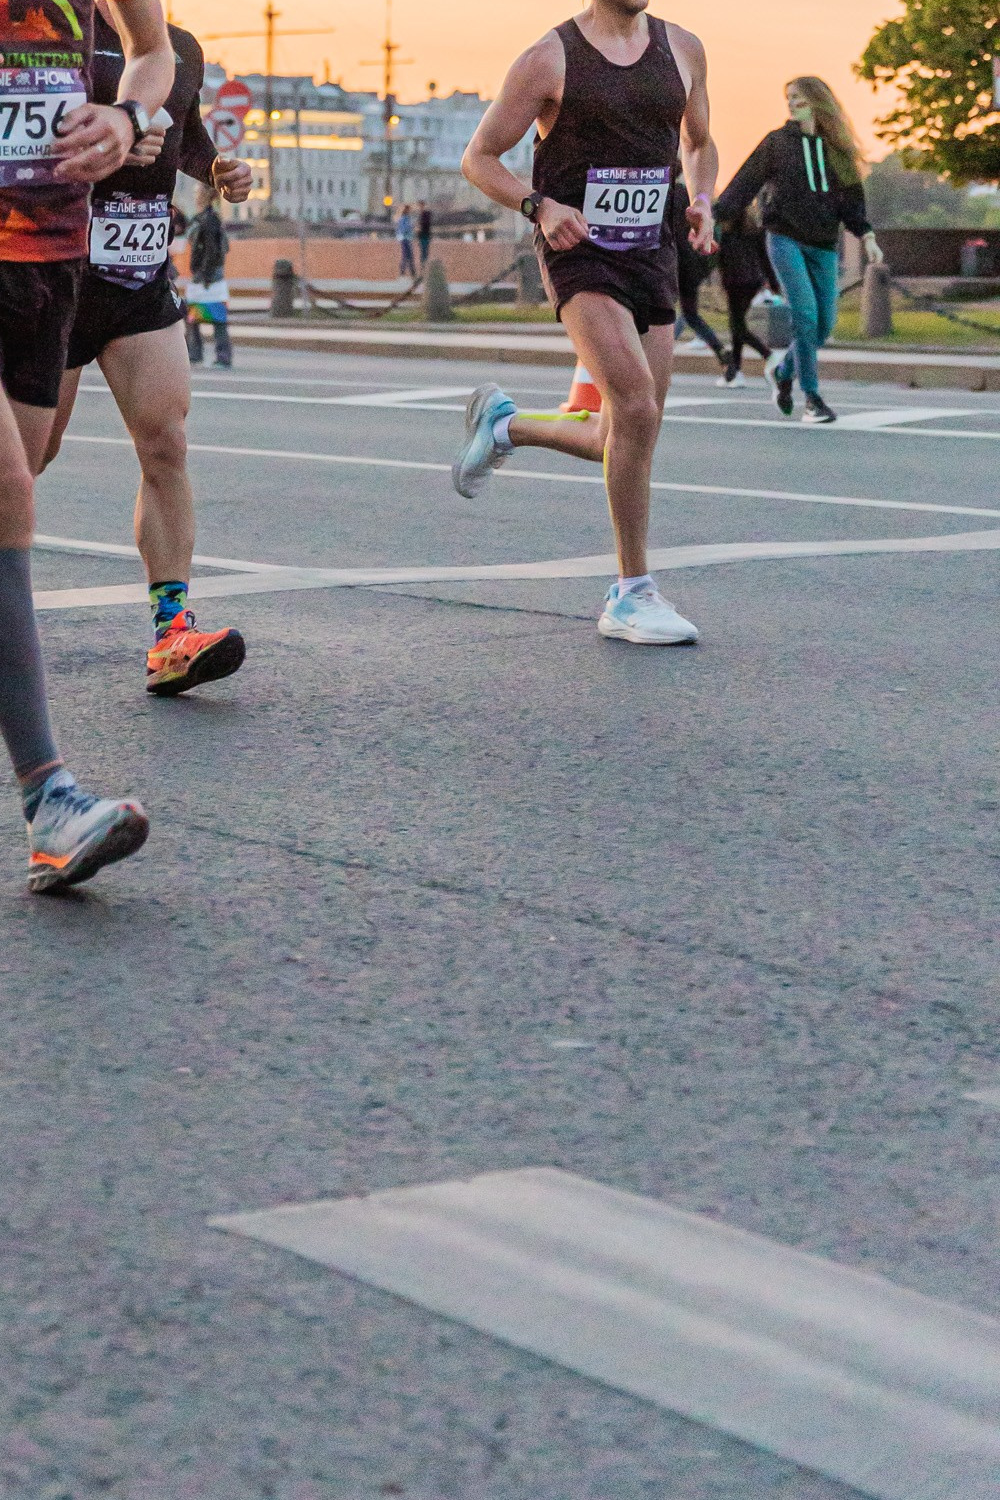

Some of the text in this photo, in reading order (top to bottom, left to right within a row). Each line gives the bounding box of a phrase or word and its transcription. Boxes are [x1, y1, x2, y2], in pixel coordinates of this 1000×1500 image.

[597, 168, 664, 180] БЕЛЫЕ НОЧИ
[595, 188, 660, 214] 4002
[616, 216, 640, 224] ЮРИЙ
[103, 222, 166, 251] 2423
